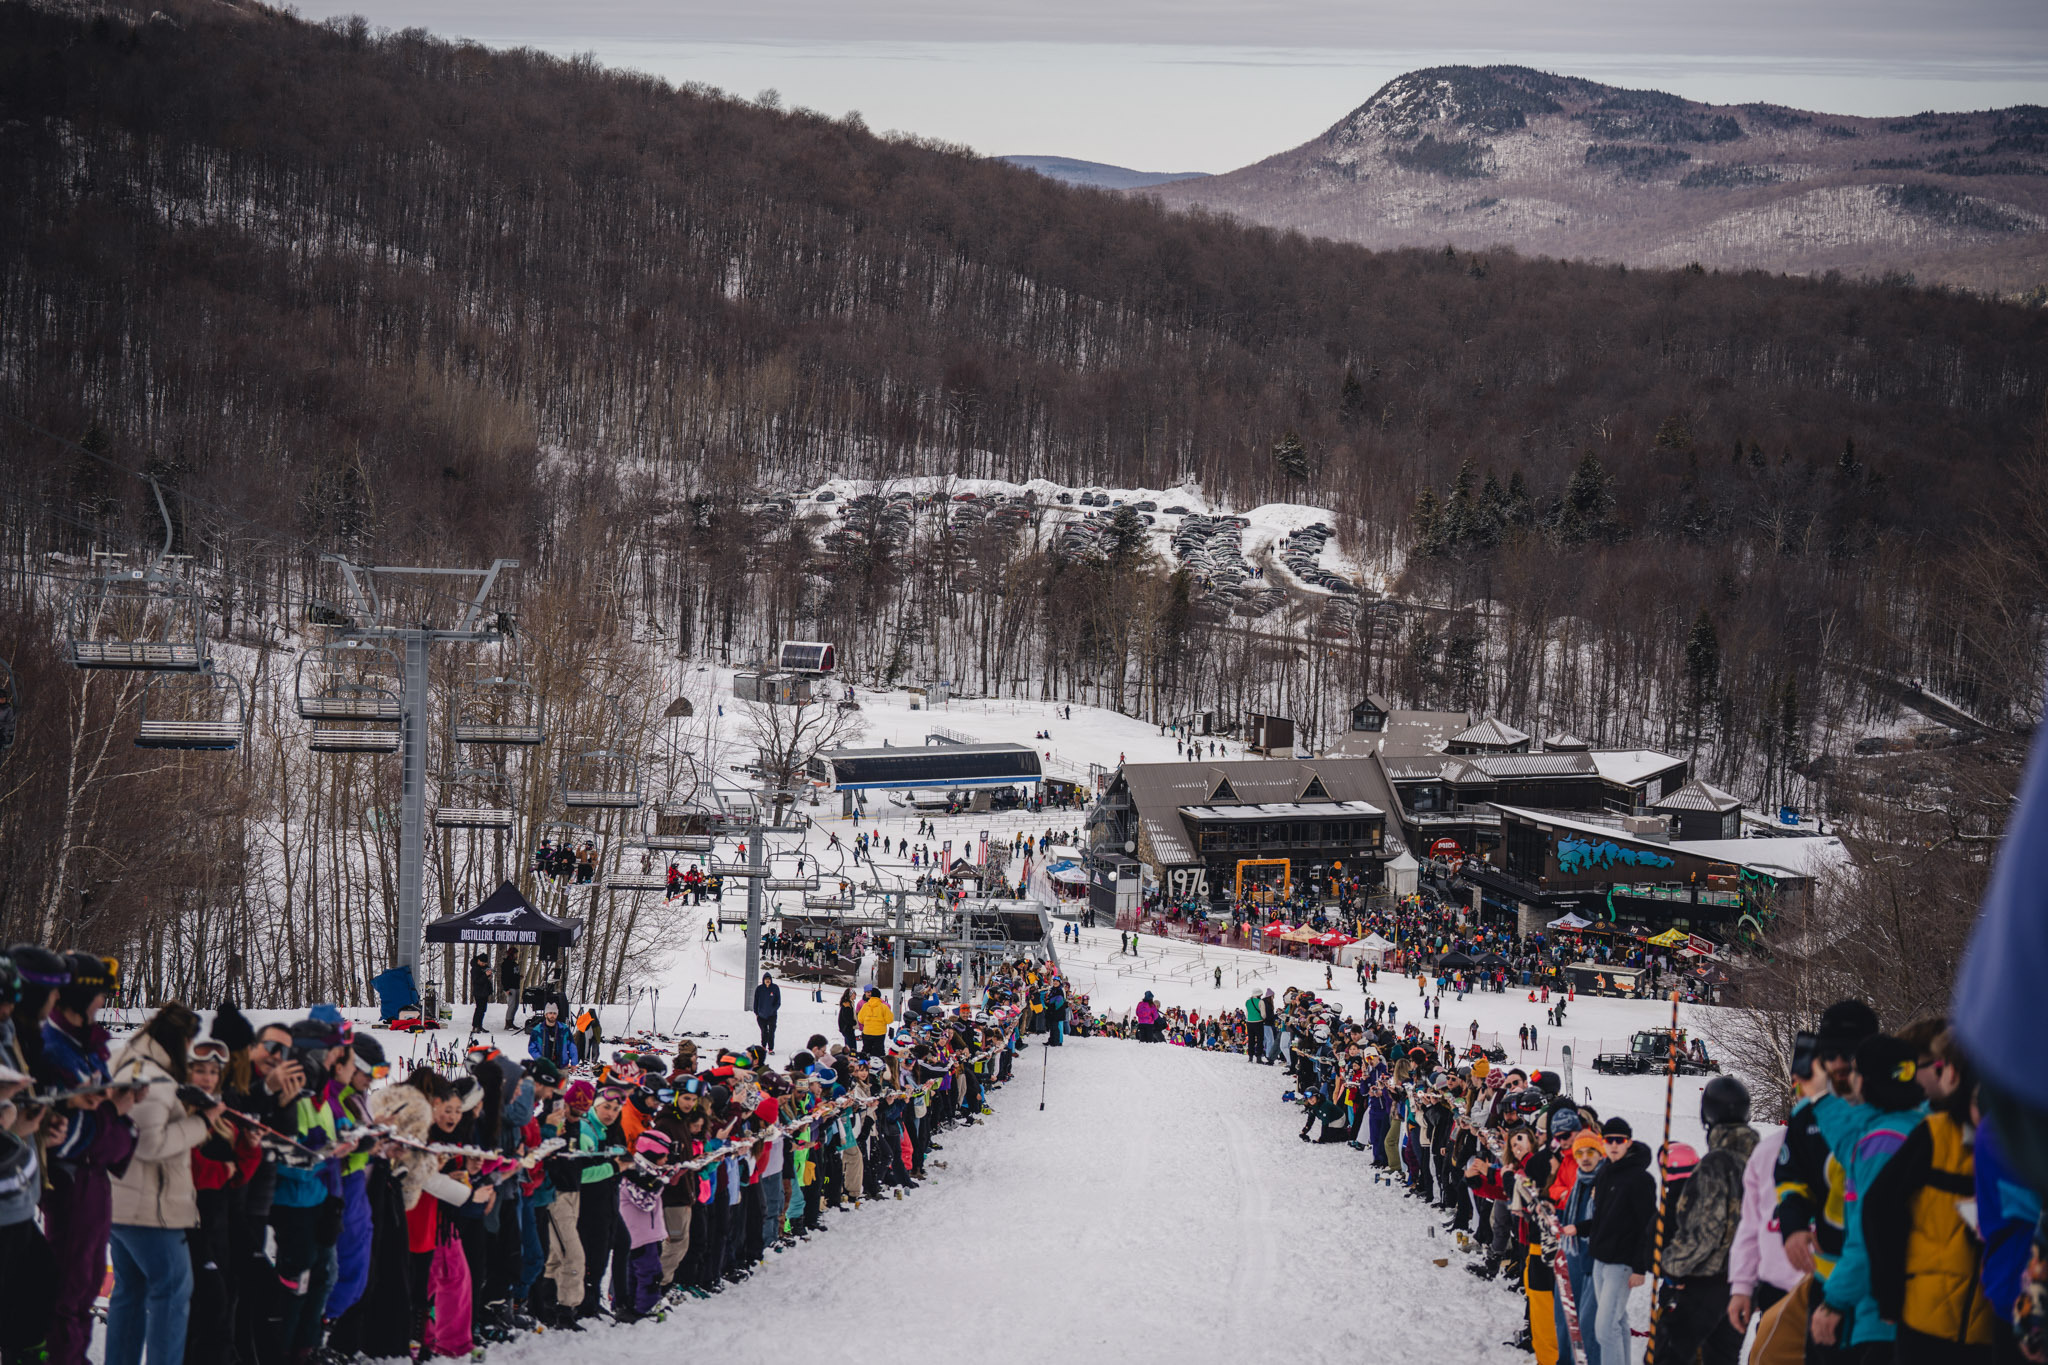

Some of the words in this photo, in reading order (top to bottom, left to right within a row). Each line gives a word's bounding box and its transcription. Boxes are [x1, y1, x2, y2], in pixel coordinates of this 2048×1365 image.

[1168, 868, 1210, 897] 1976
[461, 929, 494, 941] DISTILLERIE
[495, 930, 518, 942] CHERRY
[519, 931, 537, 943] RIVER
